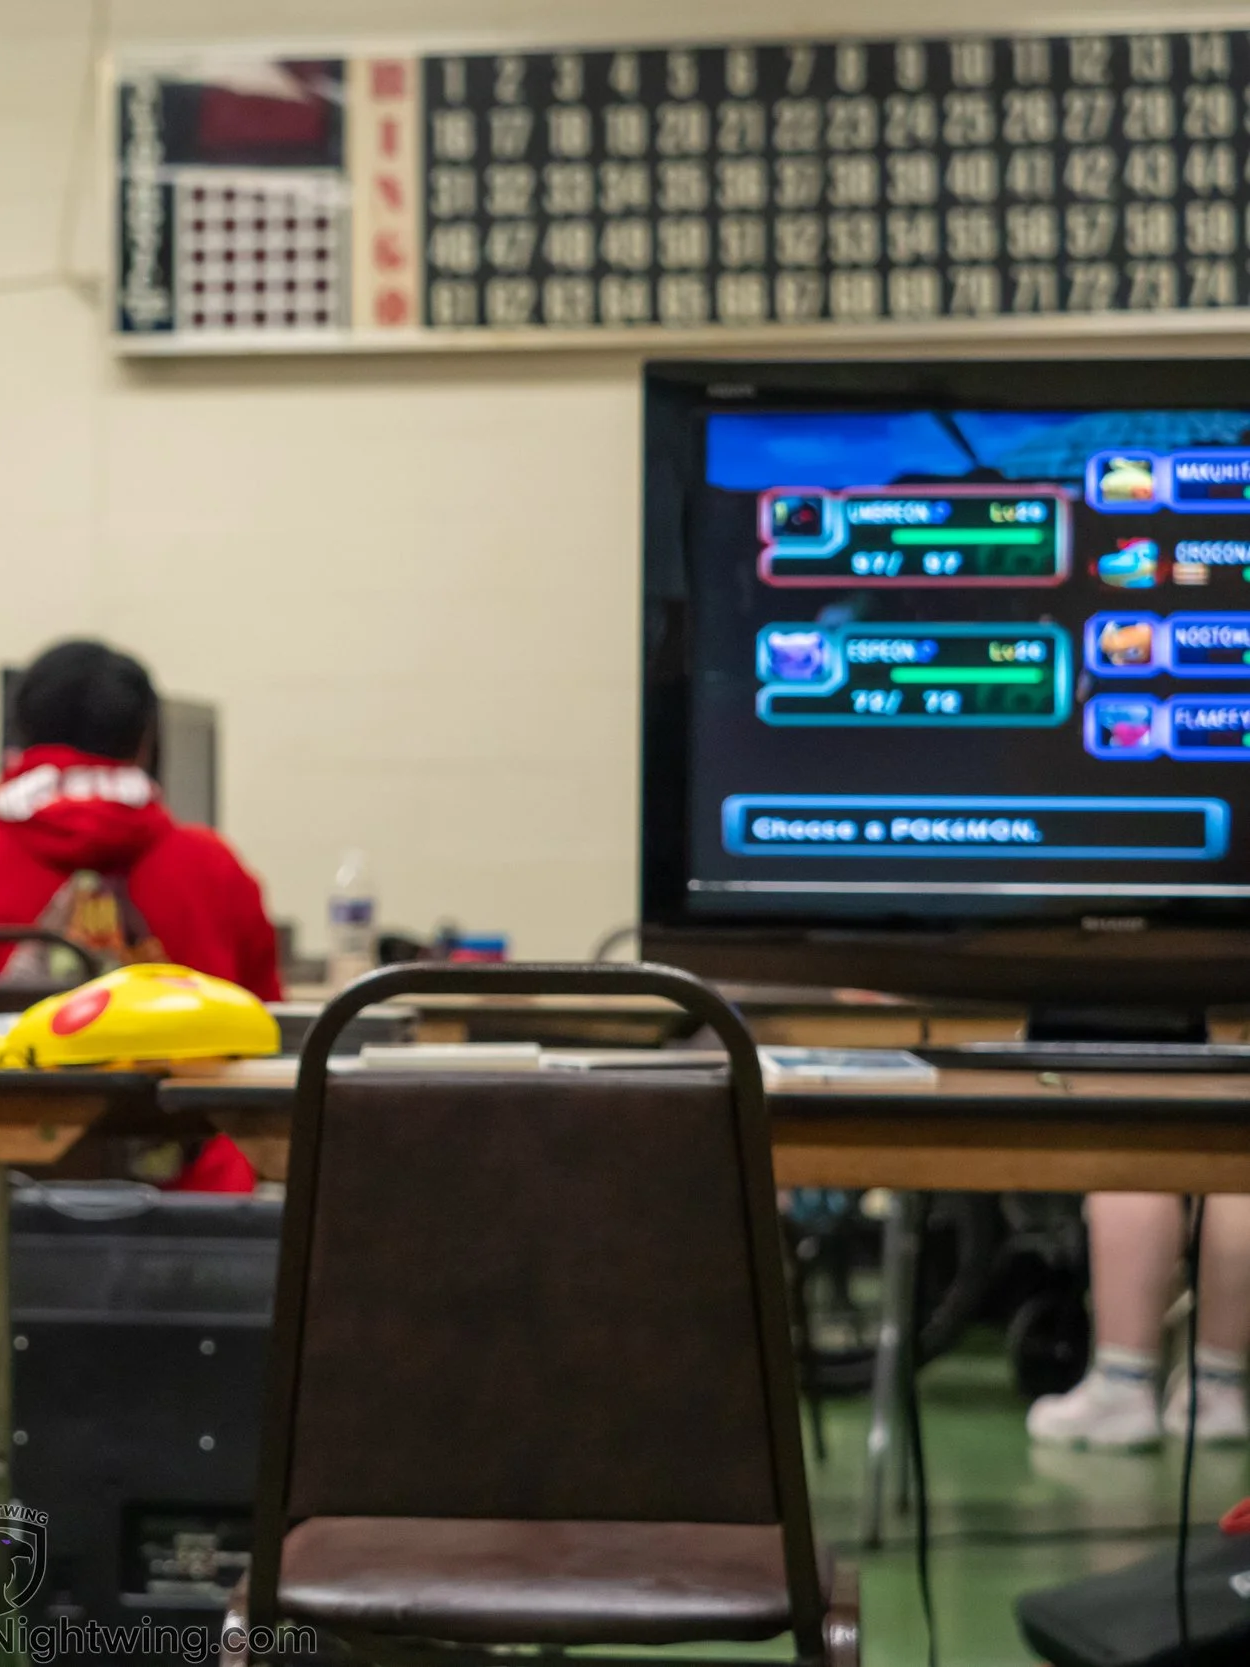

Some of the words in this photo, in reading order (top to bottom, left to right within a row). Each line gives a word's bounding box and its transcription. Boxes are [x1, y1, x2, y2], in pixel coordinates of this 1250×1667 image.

[446, 54, 464, 99] 1
[497, 54, 521, 101] 2
[556, 52, 580, 98] 3
[613, 52, 637, 93] 4
[669, 50, 695, 96] 5
[726, 48, 753, 93] 6
[787, 46, 814, 93] 7
[837, 44, 862, 90] 8
[898, 42, 923, 90] 9
[952, 40, 991, 86] 10
[1014, 38, 1049, 84] 11
[1071, 37, 1109, 84] 12
[1130, 36, 1168, 81] 13
[1190, 35, 1230, 79] 14
[752, 816, 858, 842] Choose
[865, 820, 886, 842] a
